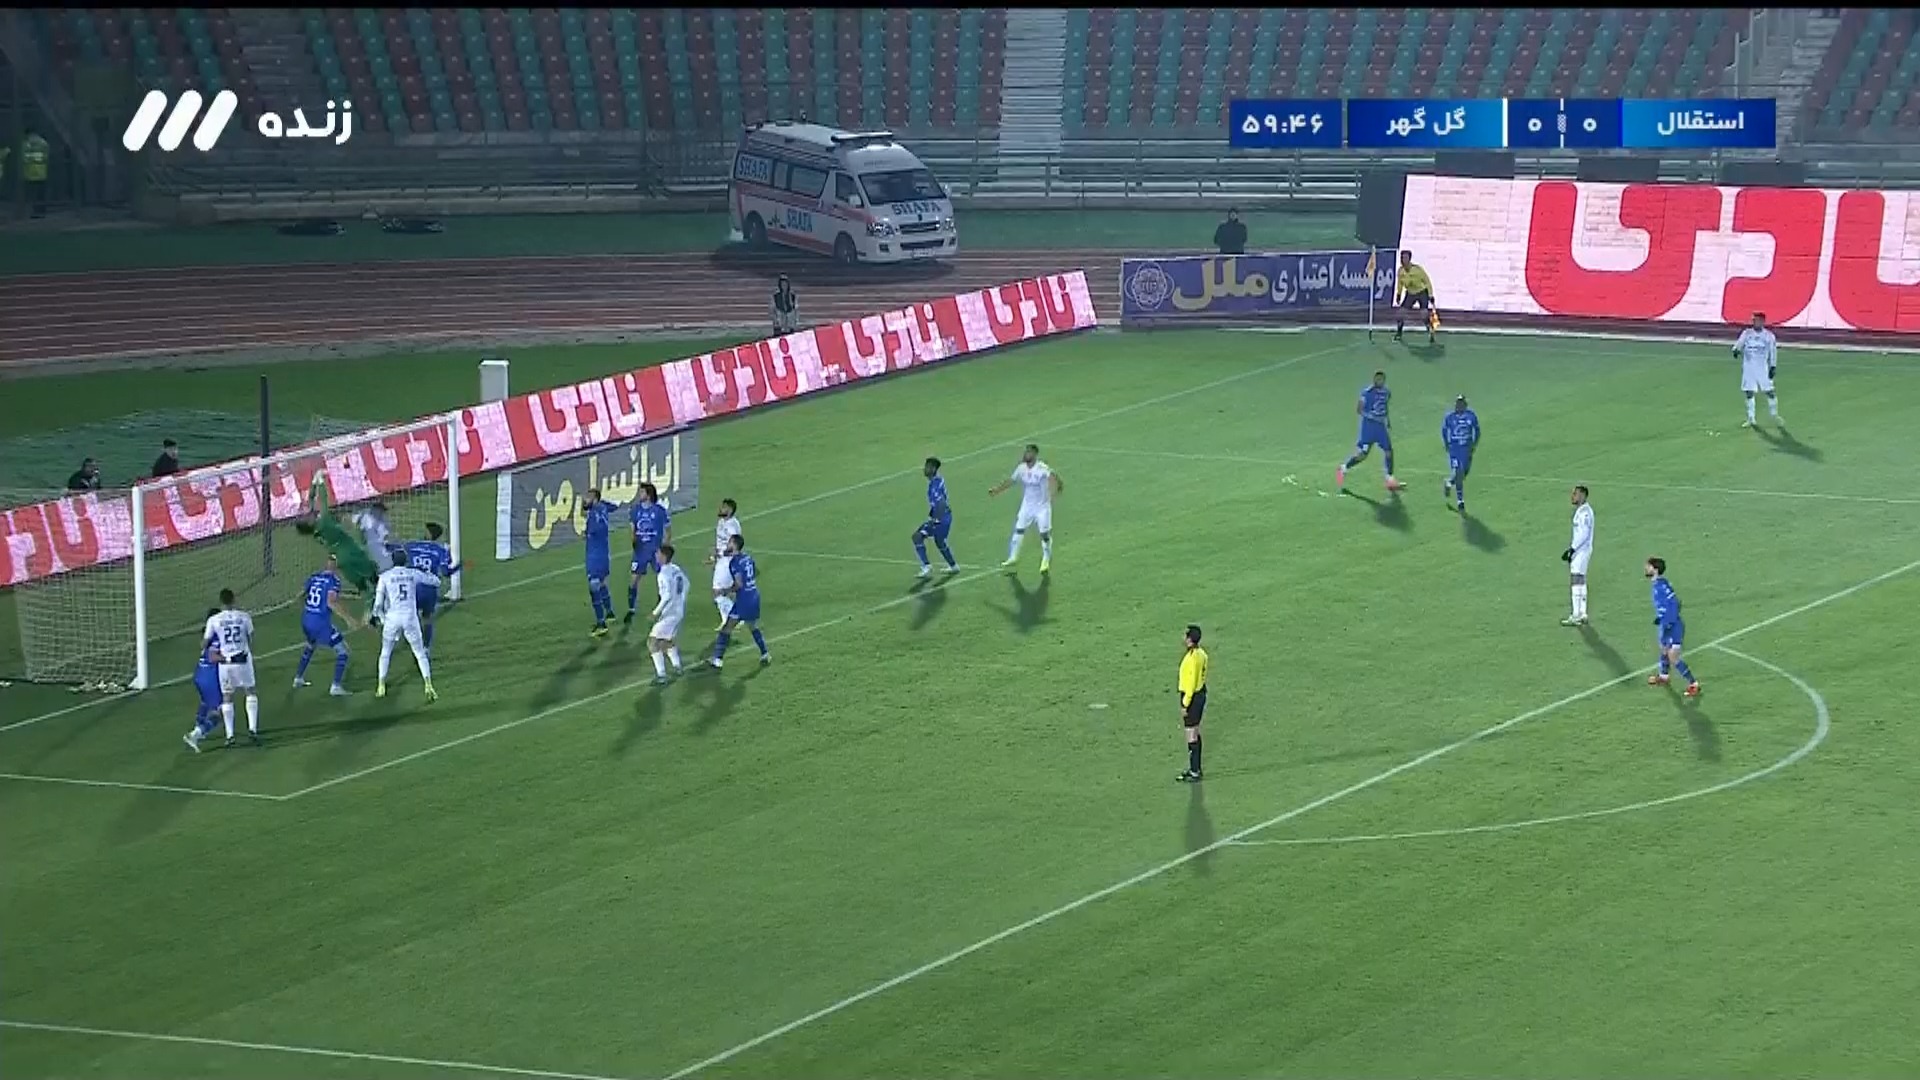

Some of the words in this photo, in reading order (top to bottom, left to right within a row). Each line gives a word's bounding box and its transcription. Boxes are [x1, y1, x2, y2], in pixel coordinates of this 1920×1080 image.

[738, 156, 768, 181] SHAFA
[787, 208, 812, 233] SHAFA
[891, 200, 942, 216] SHAFA
[1526, 181, 1920, 333] ادی
[1171, 257, 1269, 311] ملل
[1271, 255, 1335, 304] اعتباری
[528, 479, 573, 549] من
[398, 584, 408, 601] 5
[223, 626, 241, 644] 22
